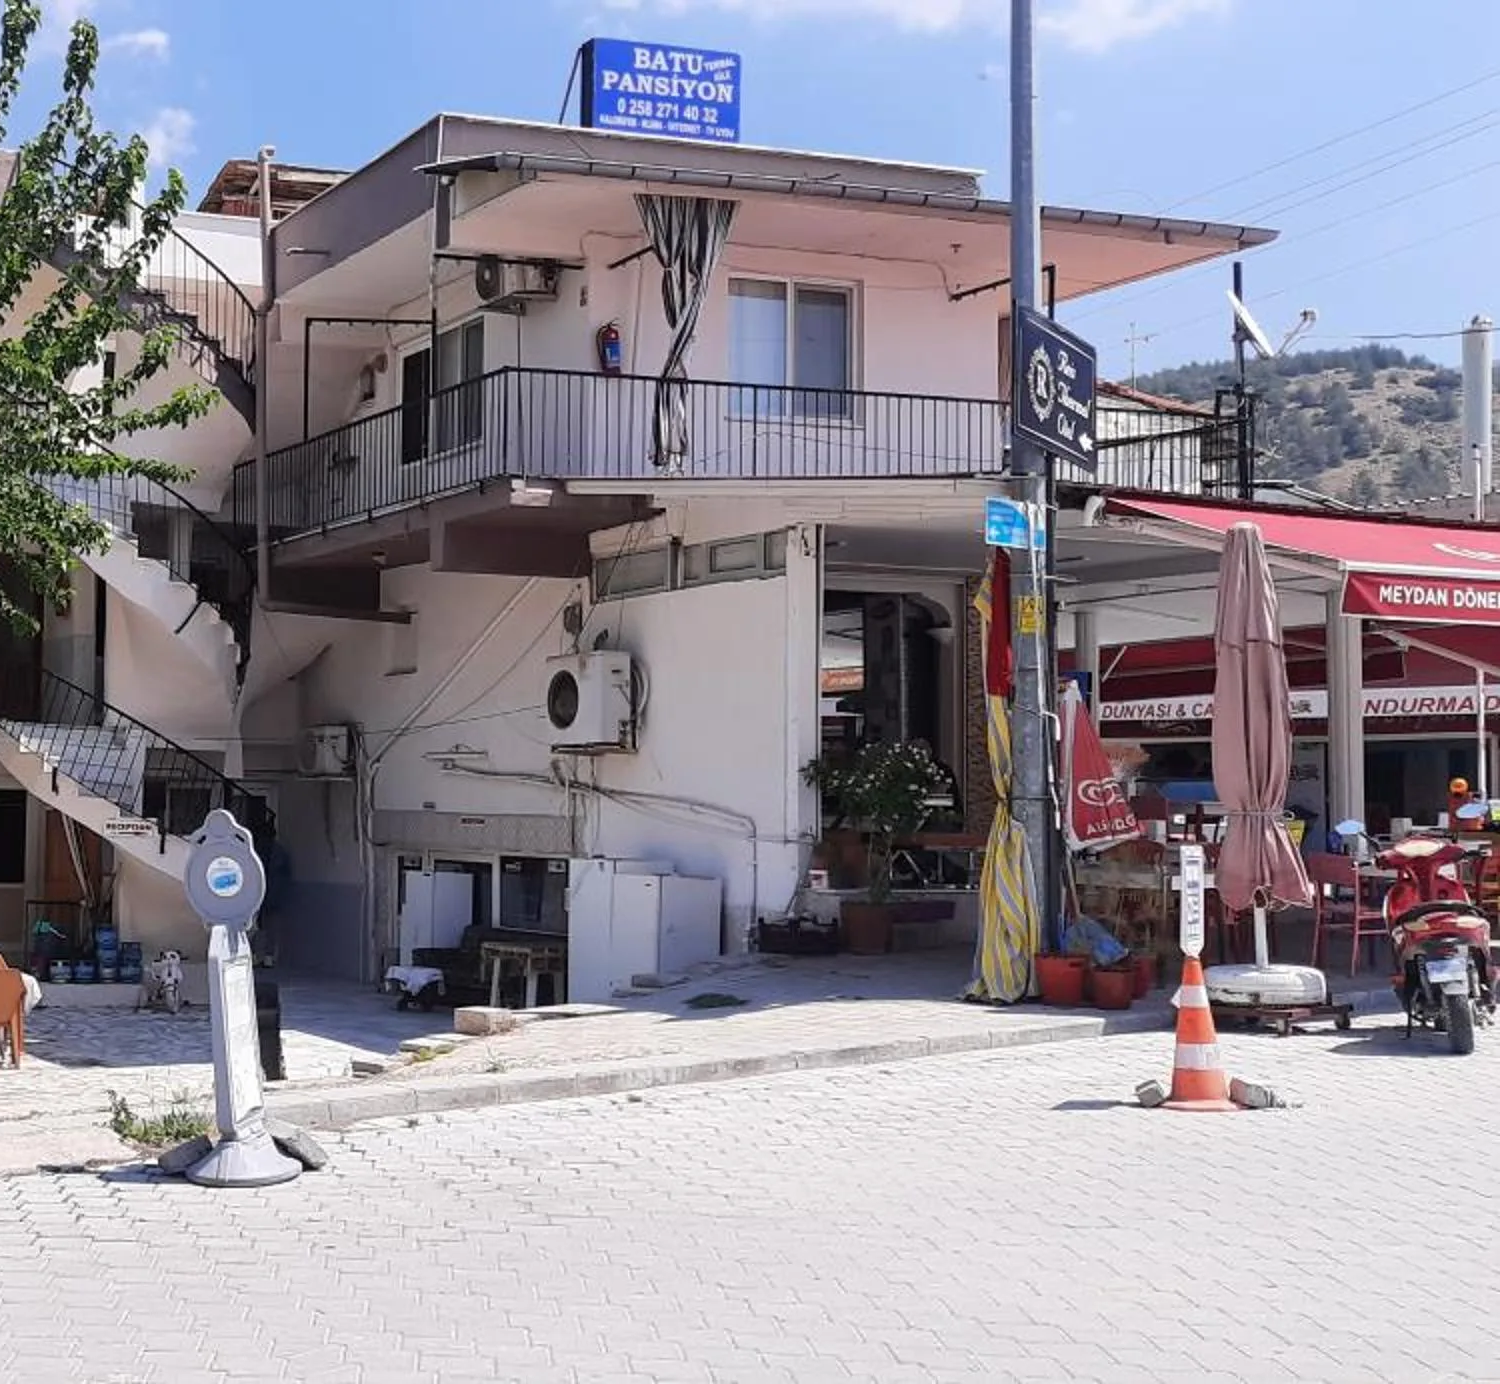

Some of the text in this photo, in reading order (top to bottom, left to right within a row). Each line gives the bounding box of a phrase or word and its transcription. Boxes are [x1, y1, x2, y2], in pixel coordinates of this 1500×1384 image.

[633, 47, 703, 75] BATU
[602, 69, 734, 104] PANSİYON
[617, 97, 718, 123] 0 258 271 40 32
[1380, 584, 1500, 609] MEYDAN DÖNE
